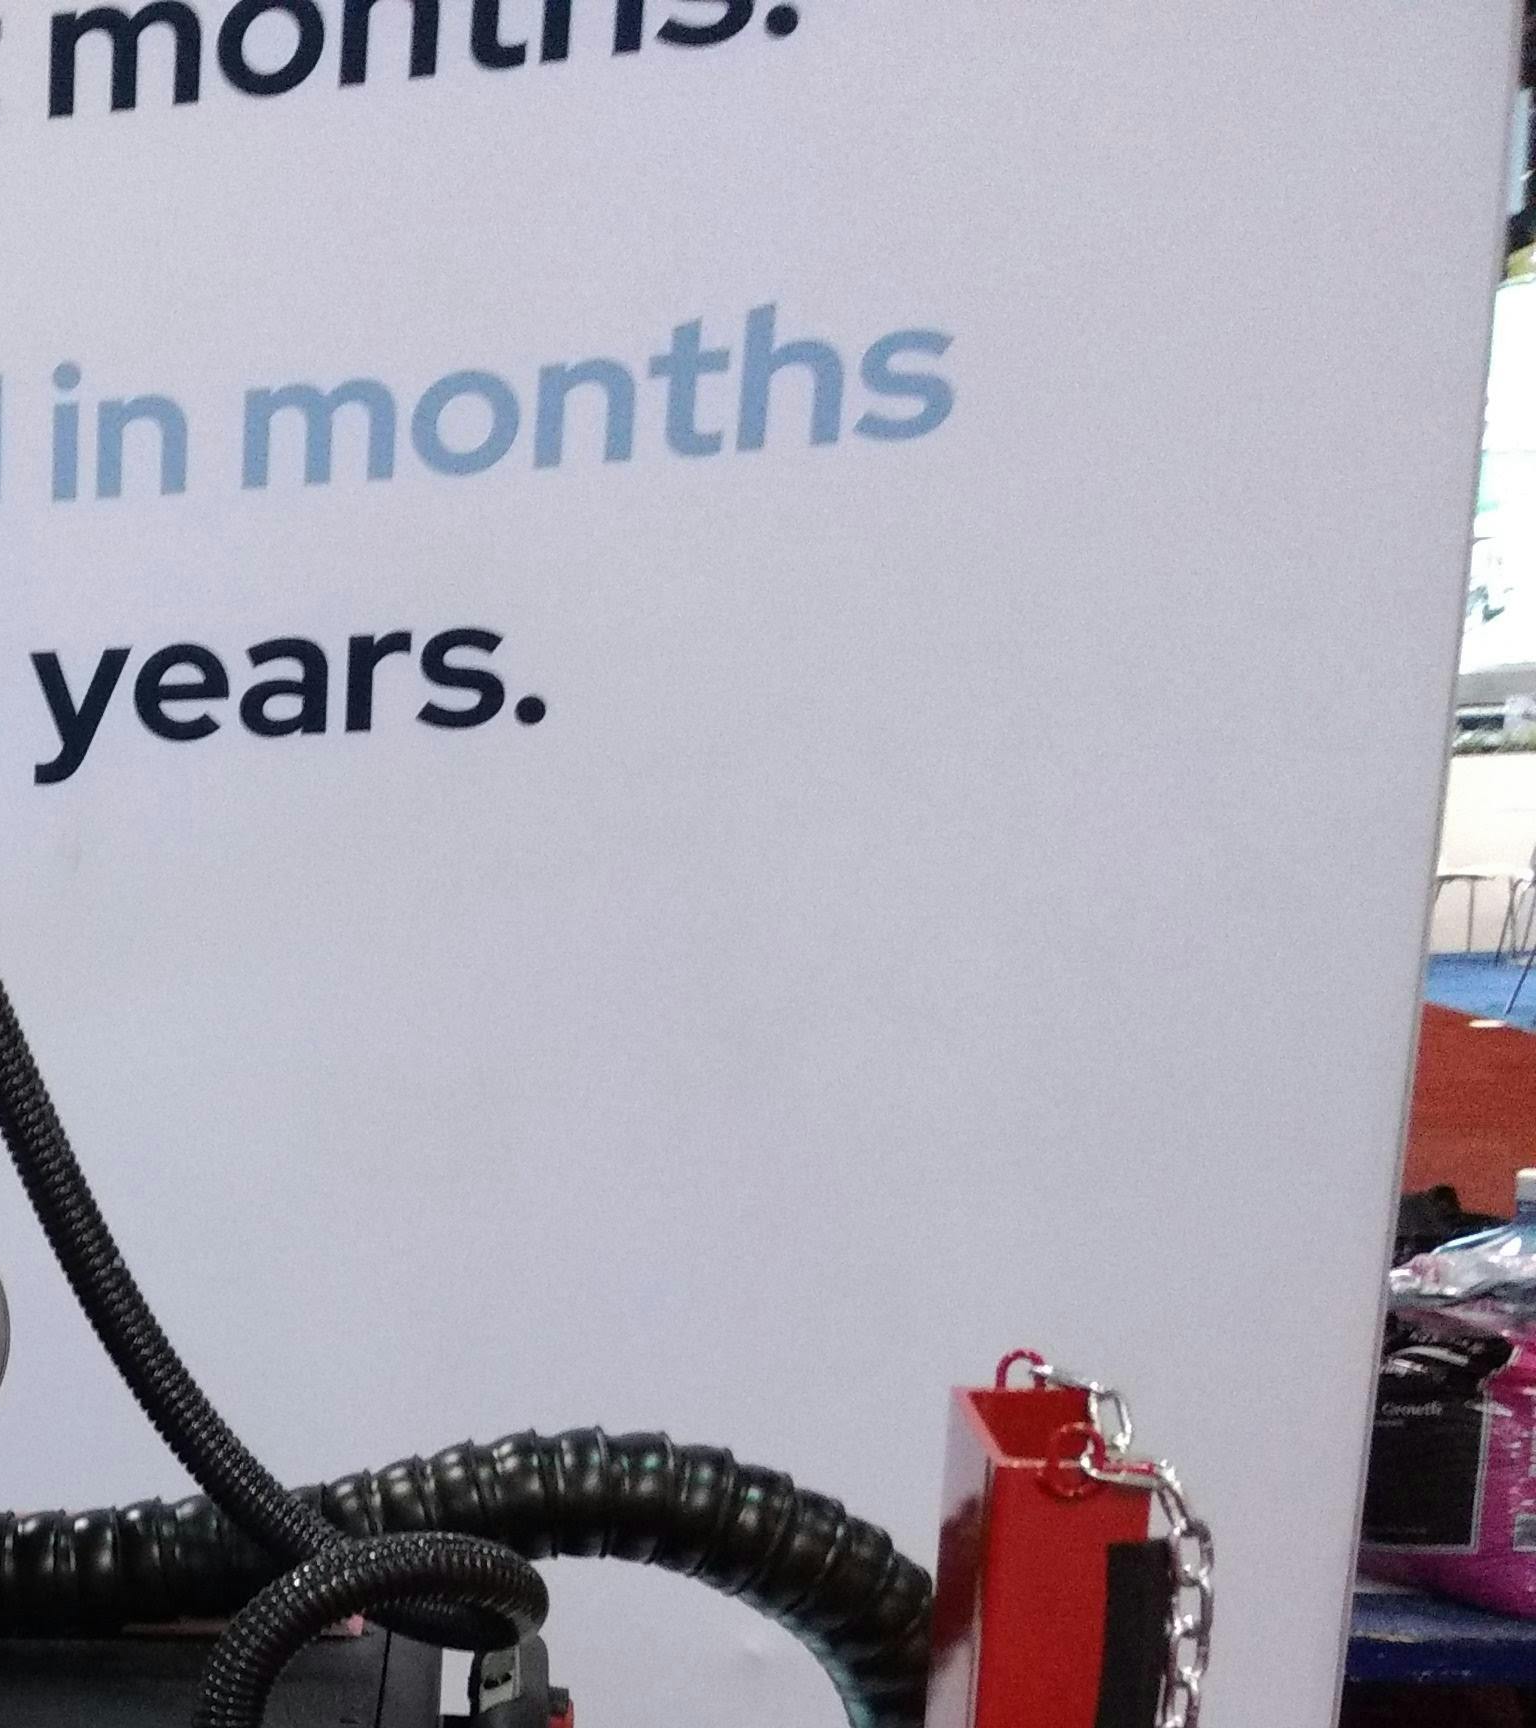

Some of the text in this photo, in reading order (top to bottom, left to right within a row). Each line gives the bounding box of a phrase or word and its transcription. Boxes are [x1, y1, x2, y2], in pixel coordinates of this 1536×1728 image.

[49, 360, 189, 505] in
[239, 302, 957, 494] months
[31, 628, 548, 786] years.
